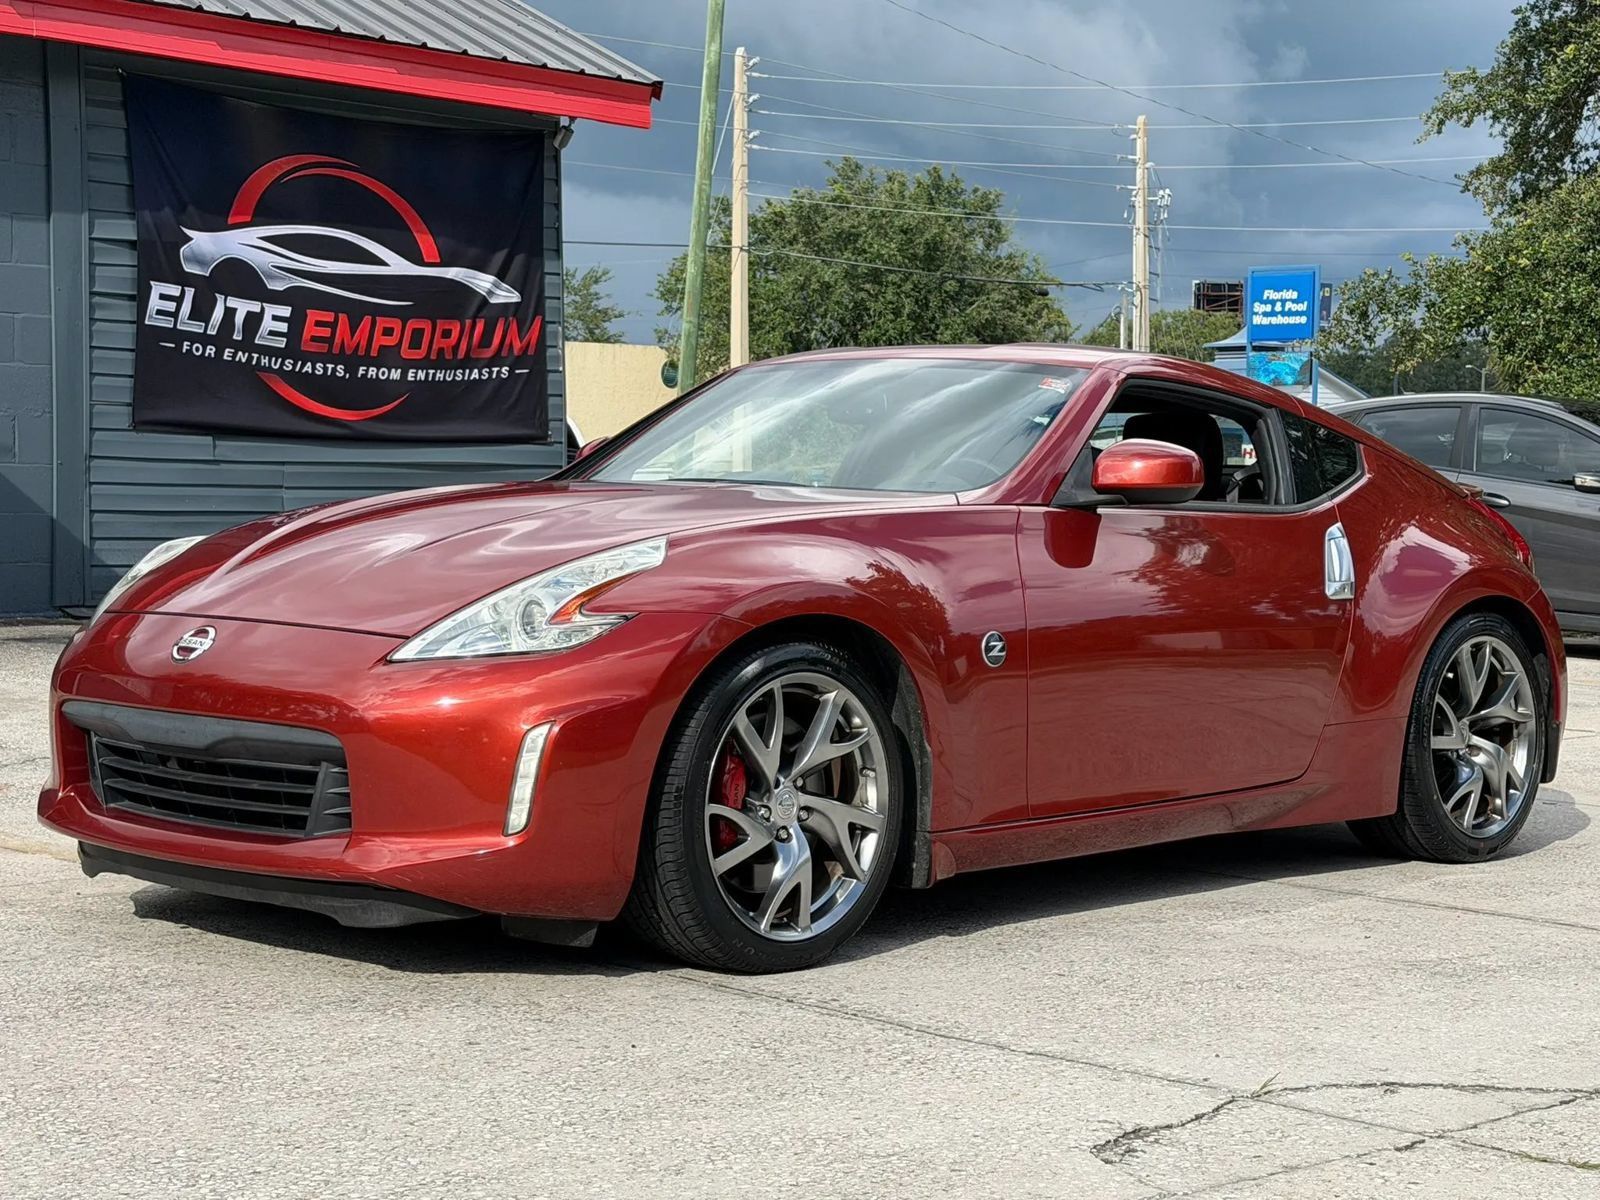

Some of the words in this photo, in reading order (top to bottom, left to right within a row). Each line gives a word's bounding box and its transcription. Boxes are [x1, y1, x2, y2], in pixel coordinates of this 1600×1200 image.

[1263, 289, 1298, 300] Florida
[1253, 301, 1272, 314] Spa
[1274, 302, 1282, 312] &
[1285, 301, 1308, 312] Pool
[144, 280, 292, 348] ELITE
[300, 309, 543, 360] EMPORIUM
[1252, 315, 1308, 325] Warehouse
[182, 341, 215, 358] FOR
[223, 349, 351, 379] ENTHUSIASTS,
[357, 366, 401, 381] FROM
[407, 366, 510, 382] ENTHUSIASTS
[987, 641, 1006, 656] Z
